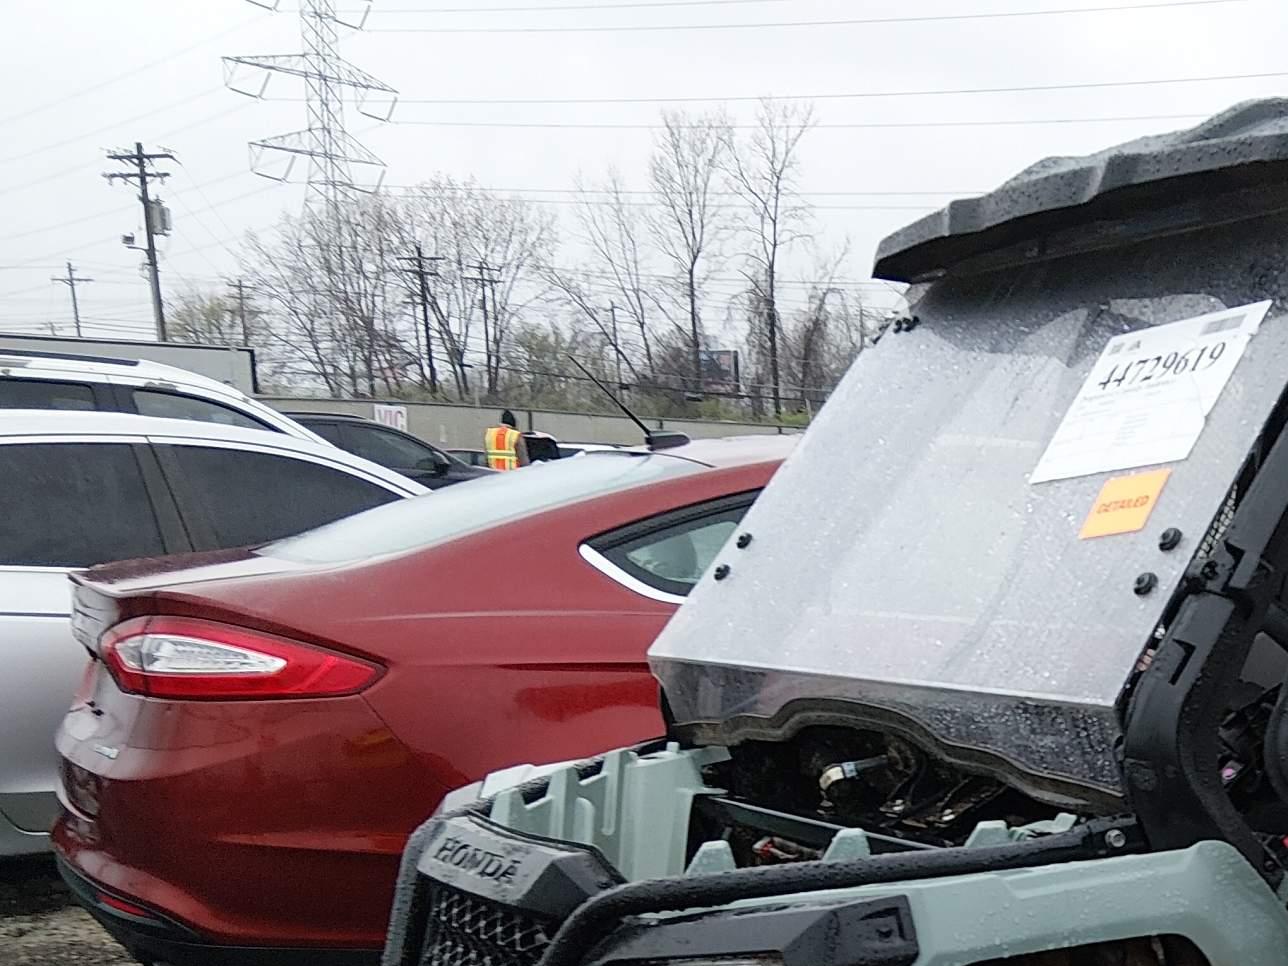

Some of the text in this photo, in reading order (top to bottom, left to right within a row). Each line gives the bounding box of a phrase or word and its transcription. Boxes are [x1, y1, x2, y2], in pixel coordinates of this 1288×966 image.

[1098, 341, 1226, 391] 44729619
[1096, 494, 1150, 514] DETAILED
[433, 837, 522, 884] HONDA
